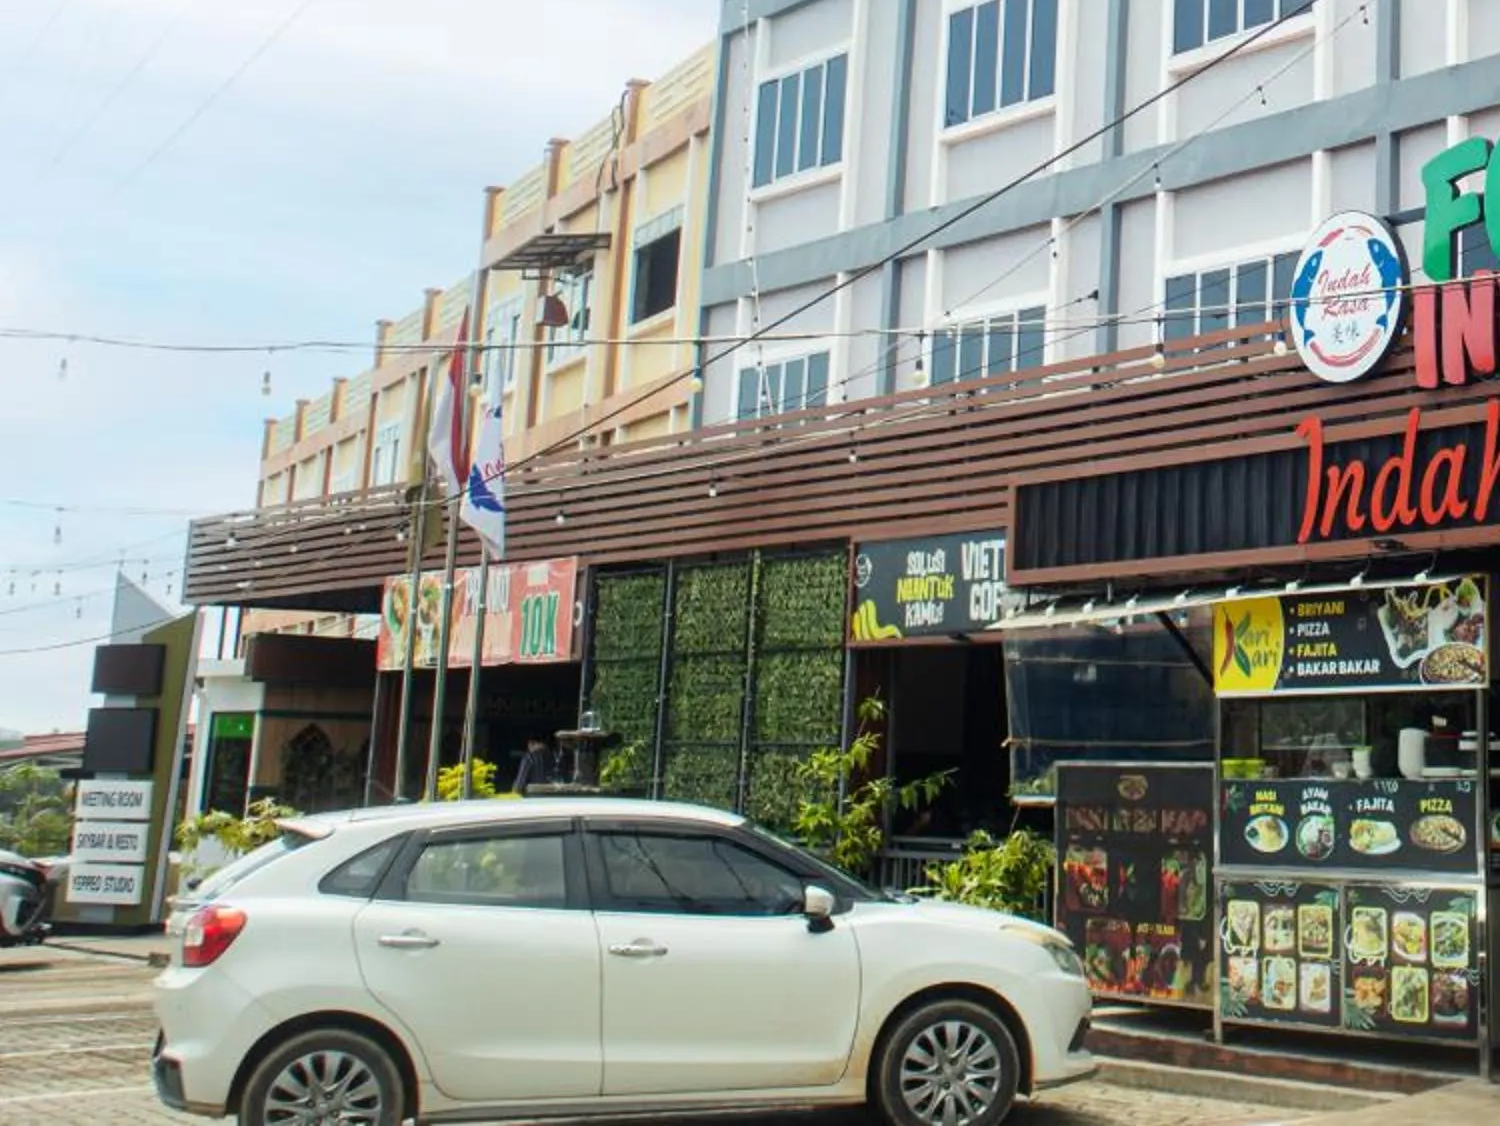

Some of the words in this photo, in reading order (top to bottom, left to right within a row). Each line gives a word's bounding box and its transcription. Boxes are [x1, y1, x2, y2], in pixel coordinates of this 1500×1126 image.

[1318, 262, 1372, 295] Indah
[1321, 294, 1370, 320] Rasa
[961, 538, 1006, 581] VIET
[1296, 601, 1345, 617] BRIYANI
[520, 590, 560, 658] 10K
[1297, 623, 1331, 636] PIZZA
[1296, 644, 1338, 657] FAJITA
[1297, 660, 1338, 676] BAKAR
[1339, 658, 1381, 674] BAKAR
[1356, 797, 1395, 813] FAJITA
[1419, 798, 1453, 813] PIZZA
